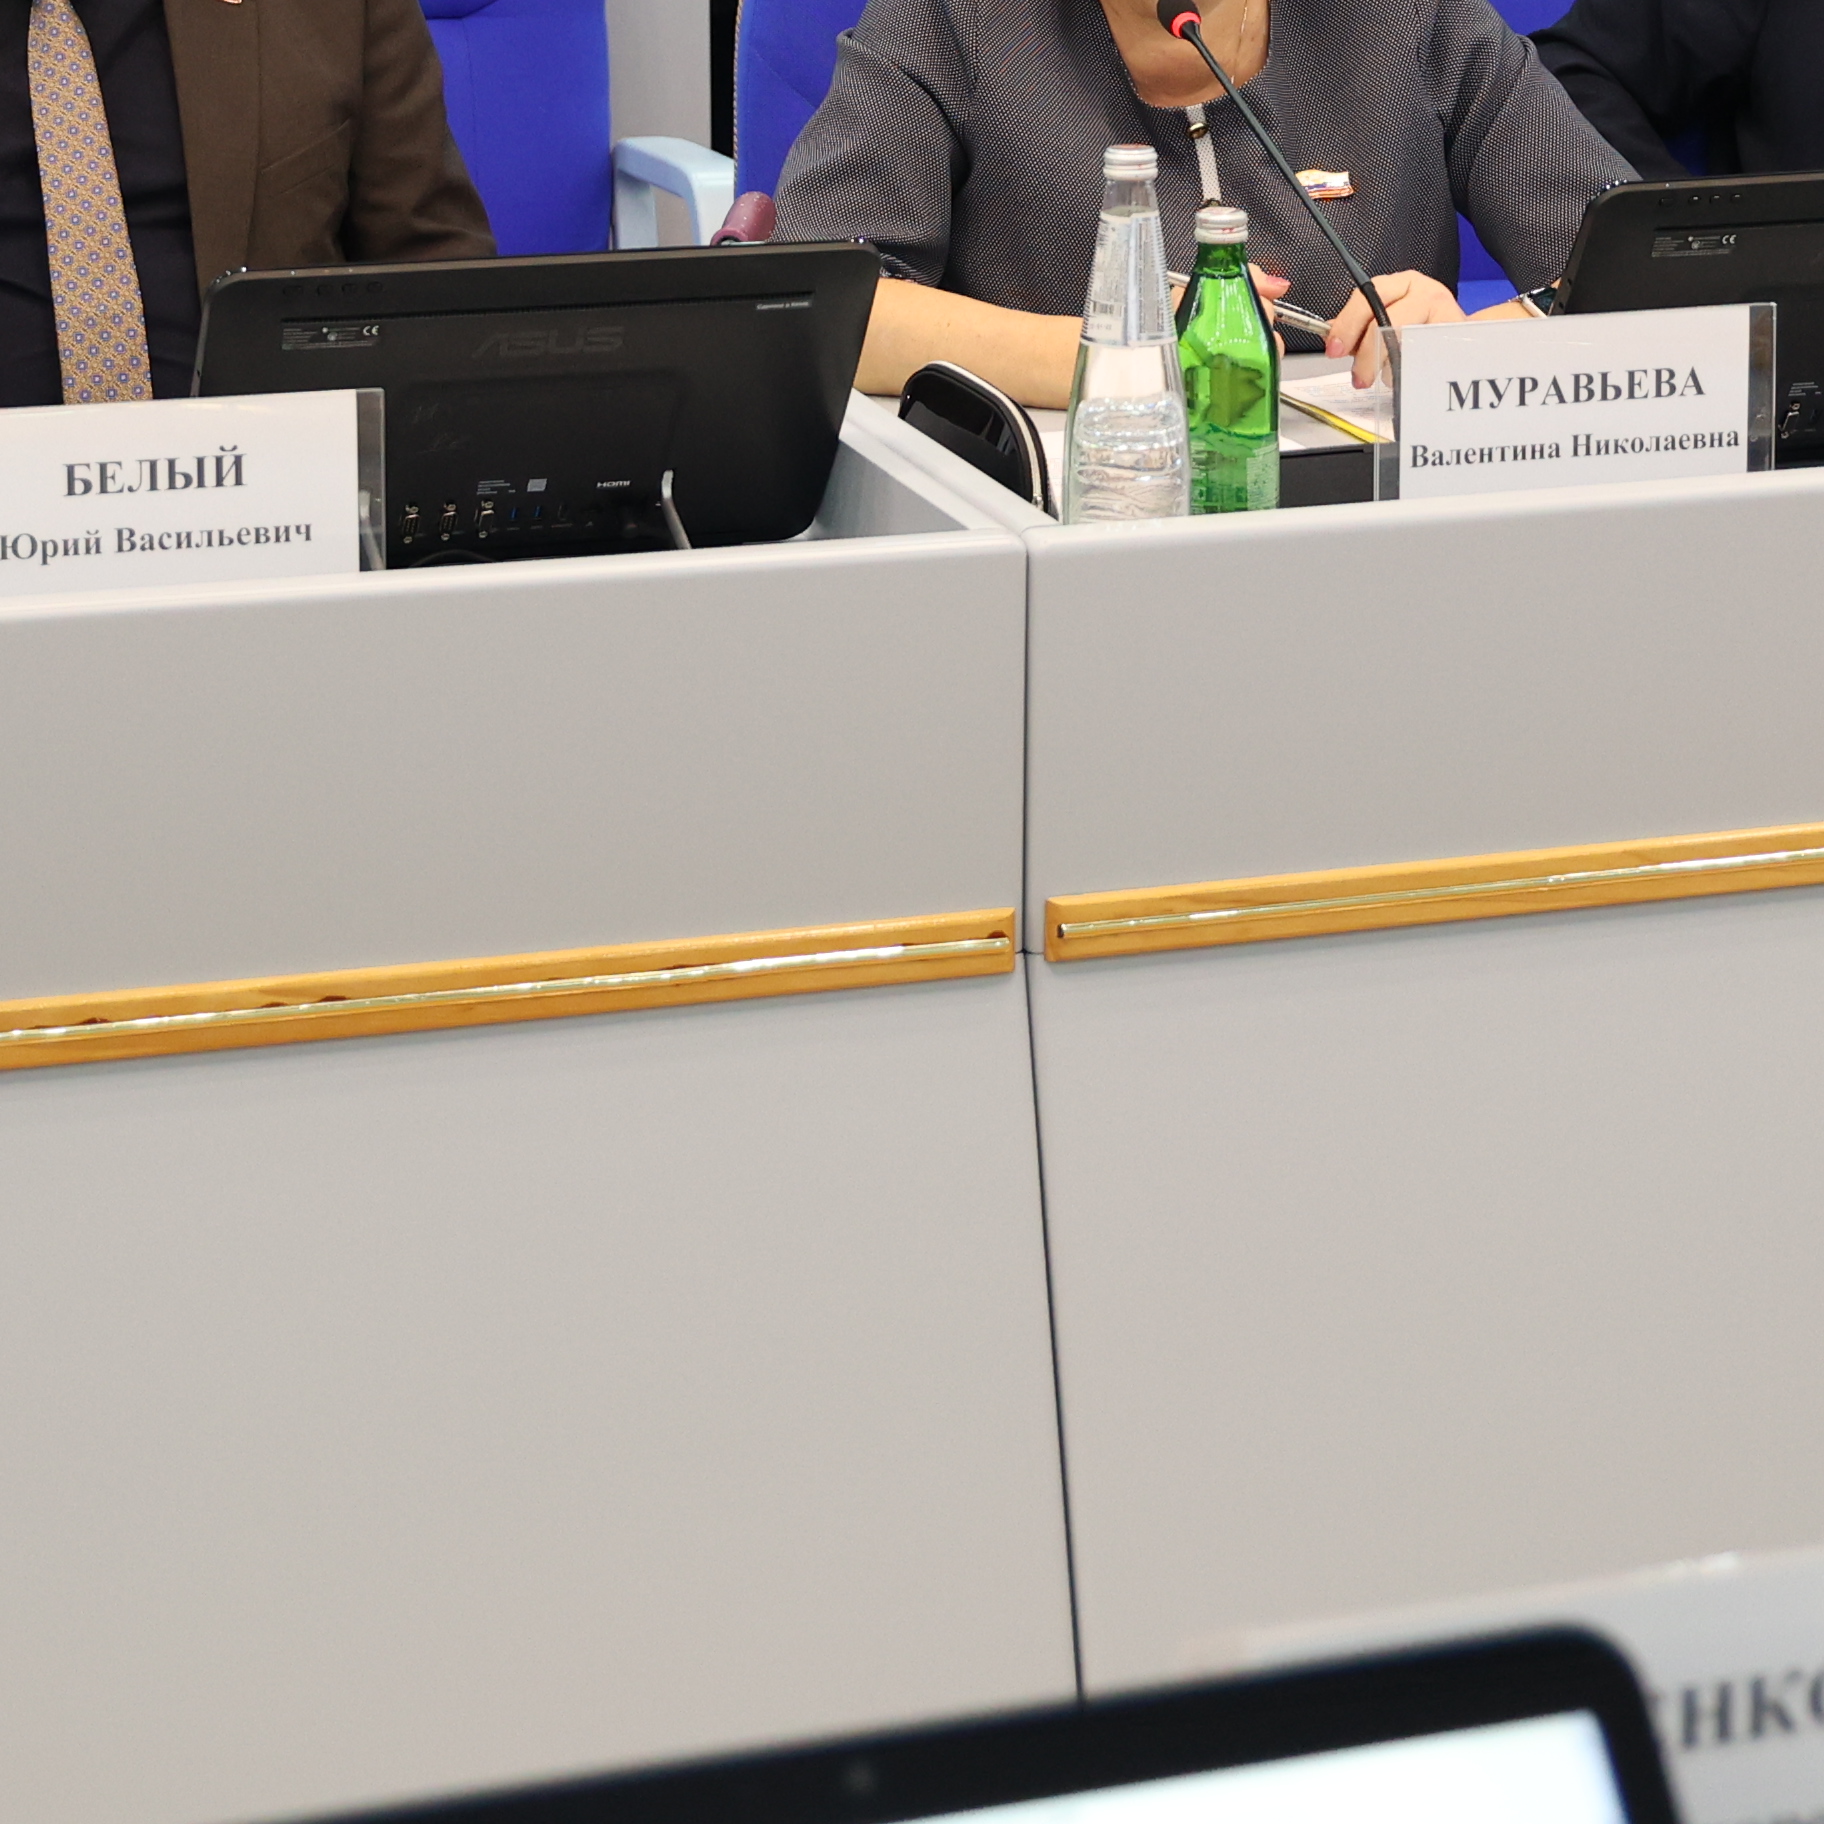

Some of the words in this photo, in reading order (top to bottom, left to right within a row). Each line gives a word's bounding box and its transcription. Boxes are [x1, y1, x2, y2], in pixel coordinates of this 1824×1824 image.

[471, 325, 625, 359] ASUS
[1446, 365, 1706, 412] МУРАВЬЕВА
[1410, 441, 1562, 469] Валентина
[1571, 426, 1741, 459] Николаевна
[63, 444, 246, 498] БЕЛЫЙ
[114, 521, 314, 555] Васильевич
